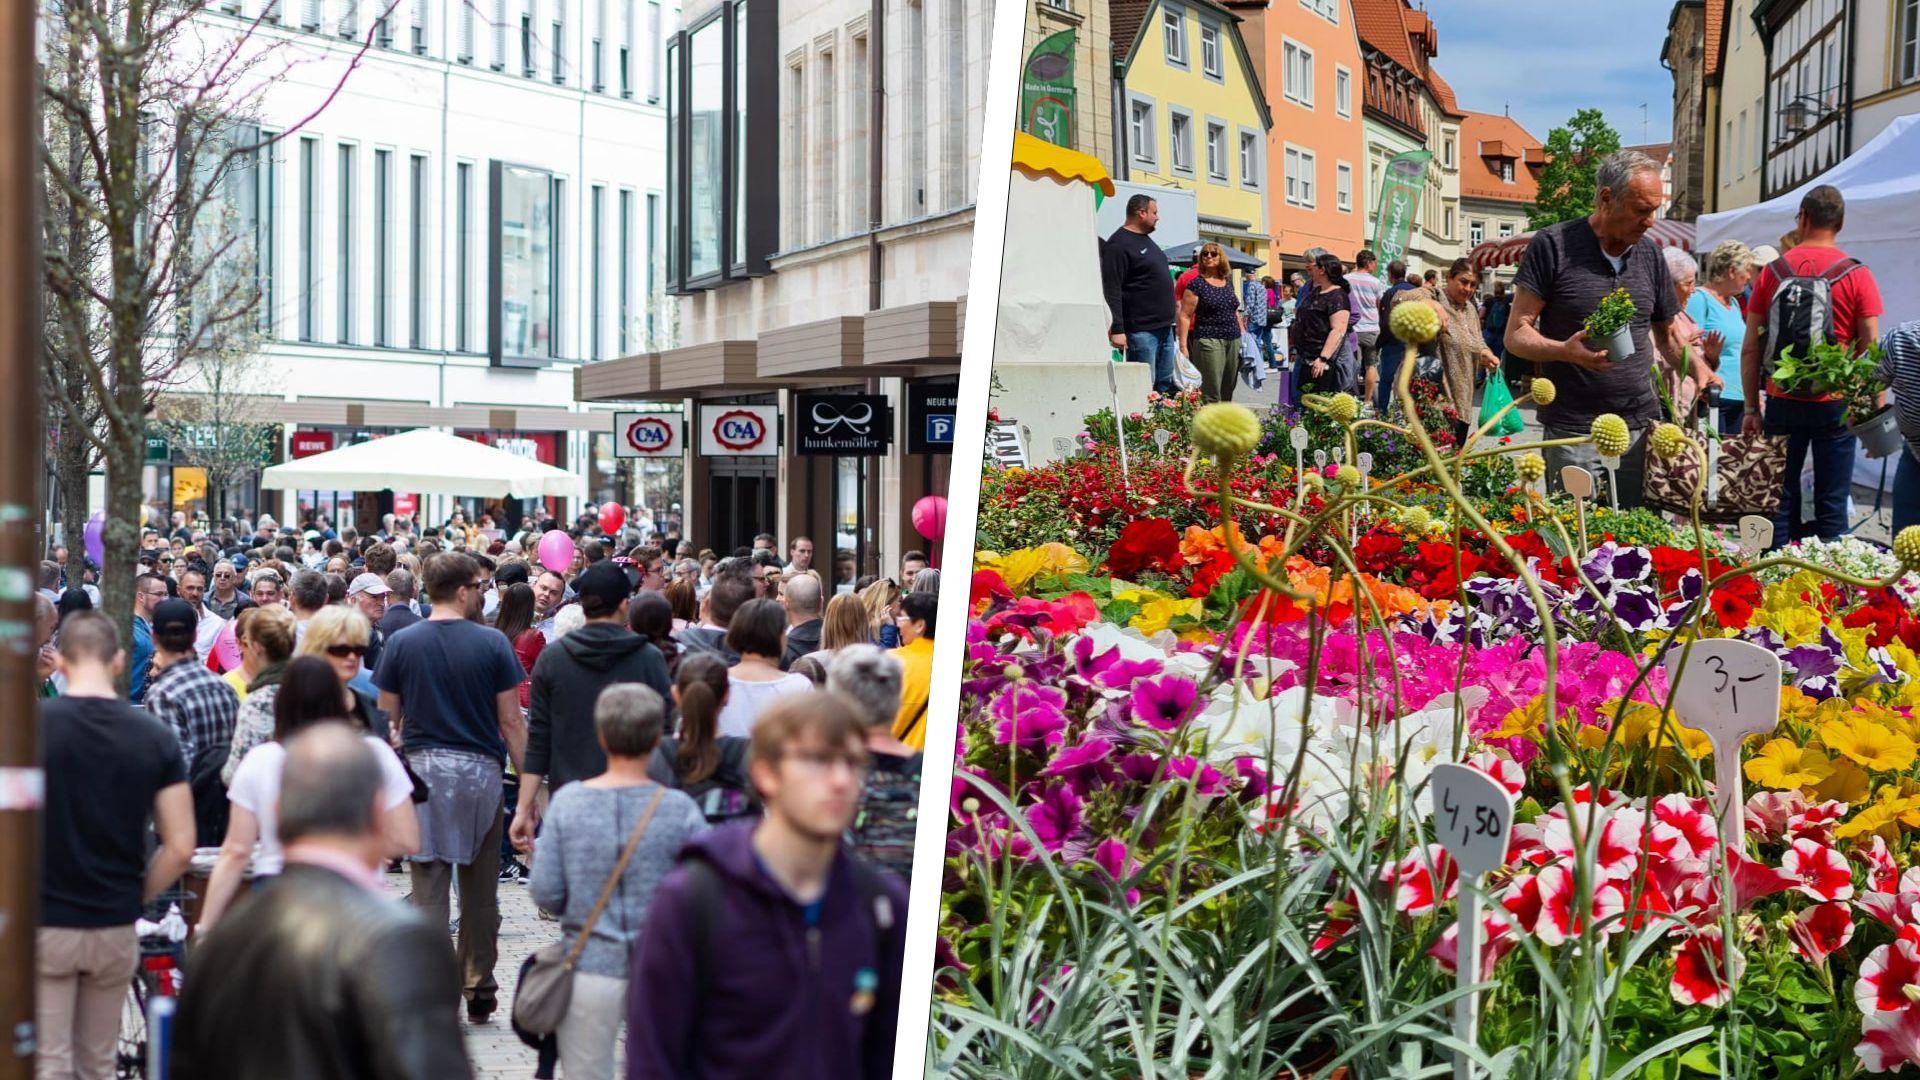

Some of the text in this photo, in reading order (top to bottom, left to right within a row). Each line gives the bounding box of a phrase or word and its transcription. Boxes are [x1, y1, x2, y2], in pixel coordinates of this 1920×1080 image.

[1025, 82, 1040, 92] Made
[926, 398, 947, 407] NEUE
[635, 427, 664, 443] C&A
[723, 421, 756, 439] C&A
[299, 441, 326, 451] REWE
[804, 436, 880, 449] hunkemöller
[1443, 786, 1501, 847] 4,50
